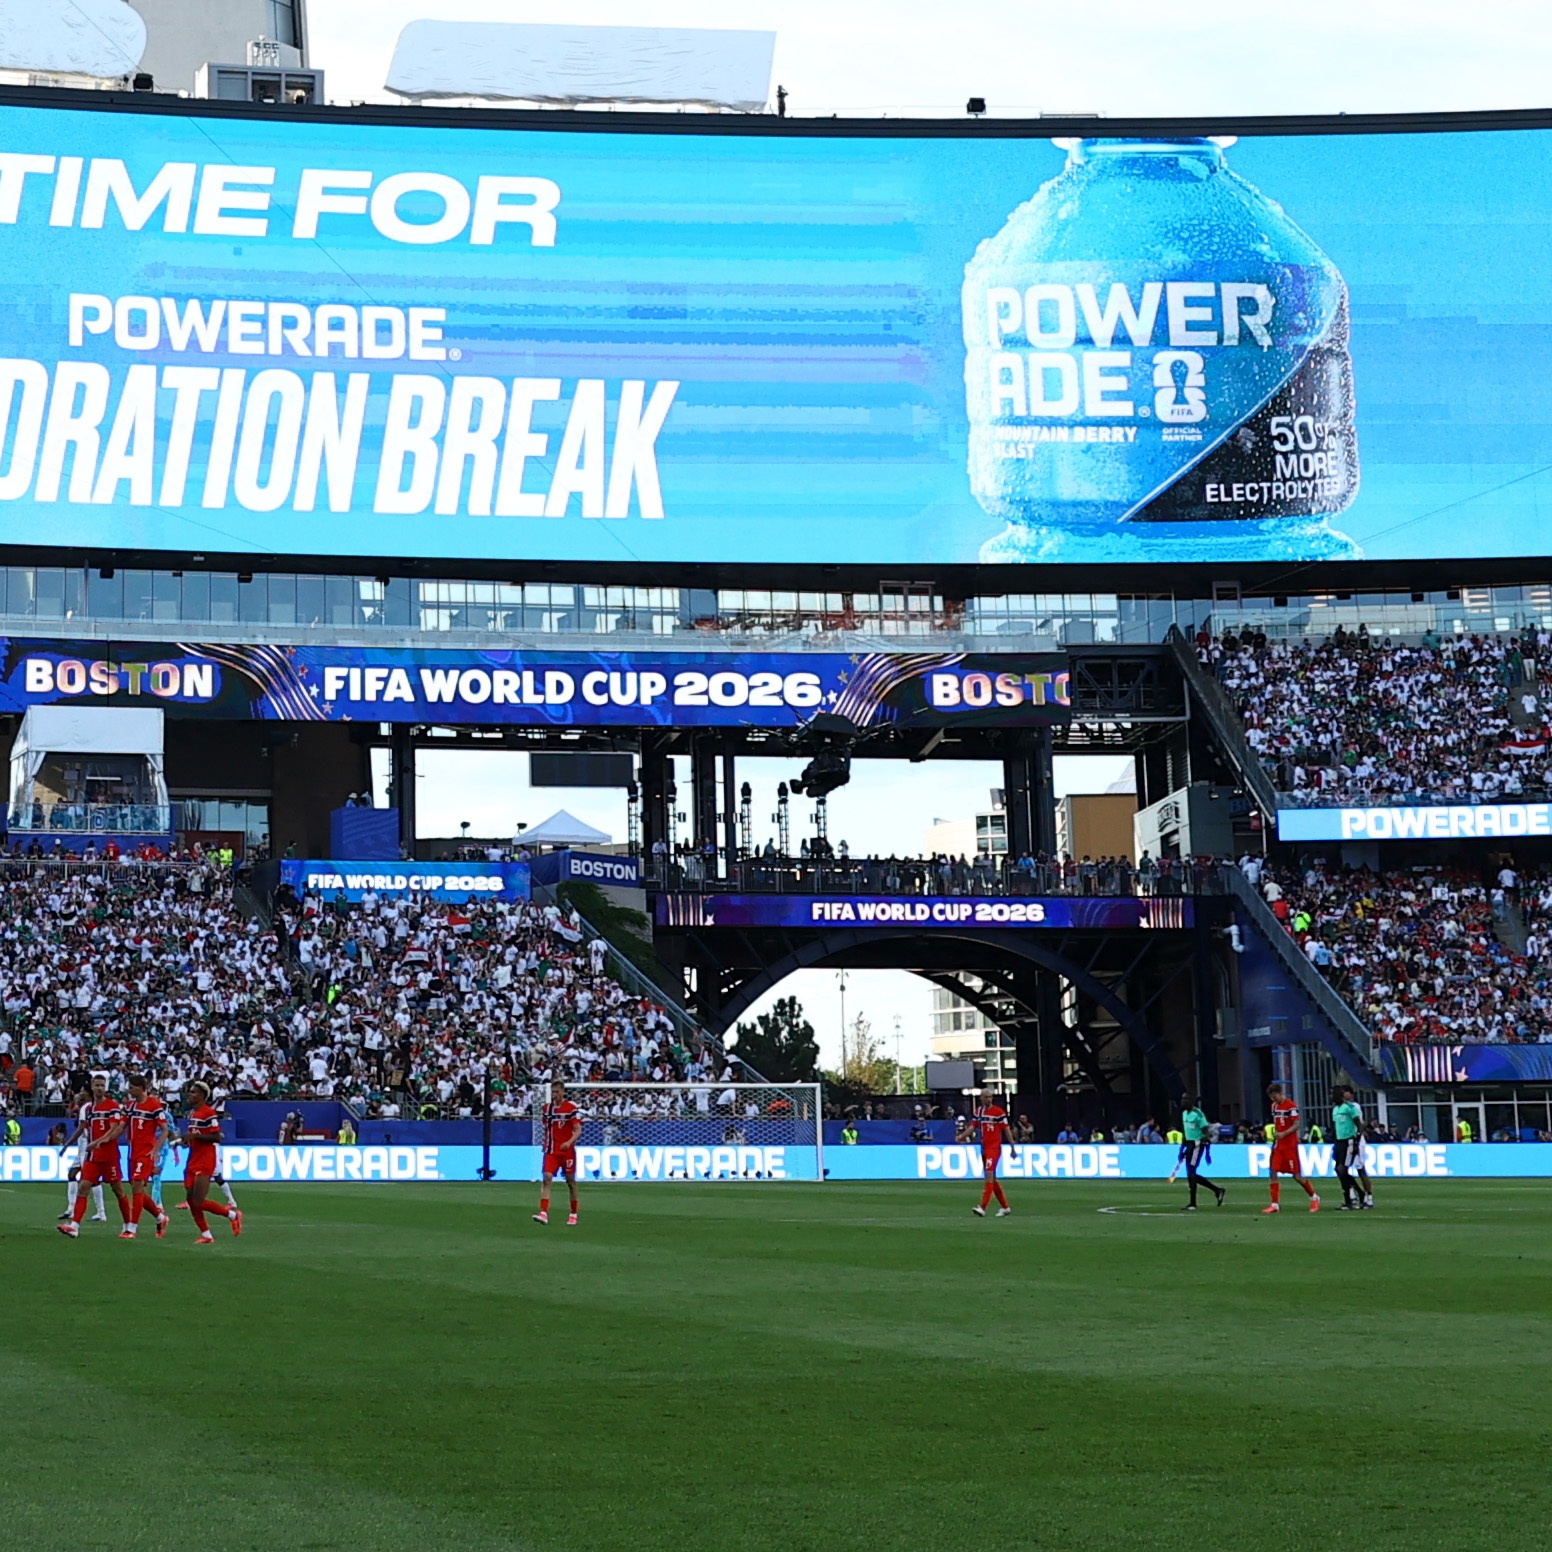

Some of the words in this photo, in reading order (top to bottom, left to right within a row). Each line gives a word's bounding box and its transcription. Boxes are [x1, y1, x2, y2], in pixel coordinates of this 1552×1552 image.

[292, 169, 562, 247] FOR
[68, 293, 447, 362] POWERADE
[987, 282, 1275, 350] POWER
[991, 350, 1135, 417] ADE
[1170, 408, 1194, 417] FIFA
[373, 373, 679, 521] BREAK
[1073, 425, 1138, 443] BERRY
[1270, 416, 1338, 451] 50%
[1274, 452, 1338, 478] MORE
[25, 658, 214, 700] BOSTON
[323, 666, 414, 703] FIFA
[415, 667, 570, 705] WORLD
[592, 669, 667, 706] CUP
[673, 672, 822, 708] 2026
[1341, 804, 1550, 839] POWERADE
[308, 874, 346, 890] FIFA
[347, 874, 408, 891] WORLD
[409, 875, 443, 891] CUP
[445, 875, 504, 892] 2026
[570, 858, 638, 882] BOSTON
[812, 903, 855, 921] FIFA
[857, 903, 931, 921] WORLD
[933, 903, 972, 921] CUP
[975, 903, 1045, 922] 2026
[223, 1146, 438, 1179] POWERADE
[576, 1146, 785, 1179] POWERADE
